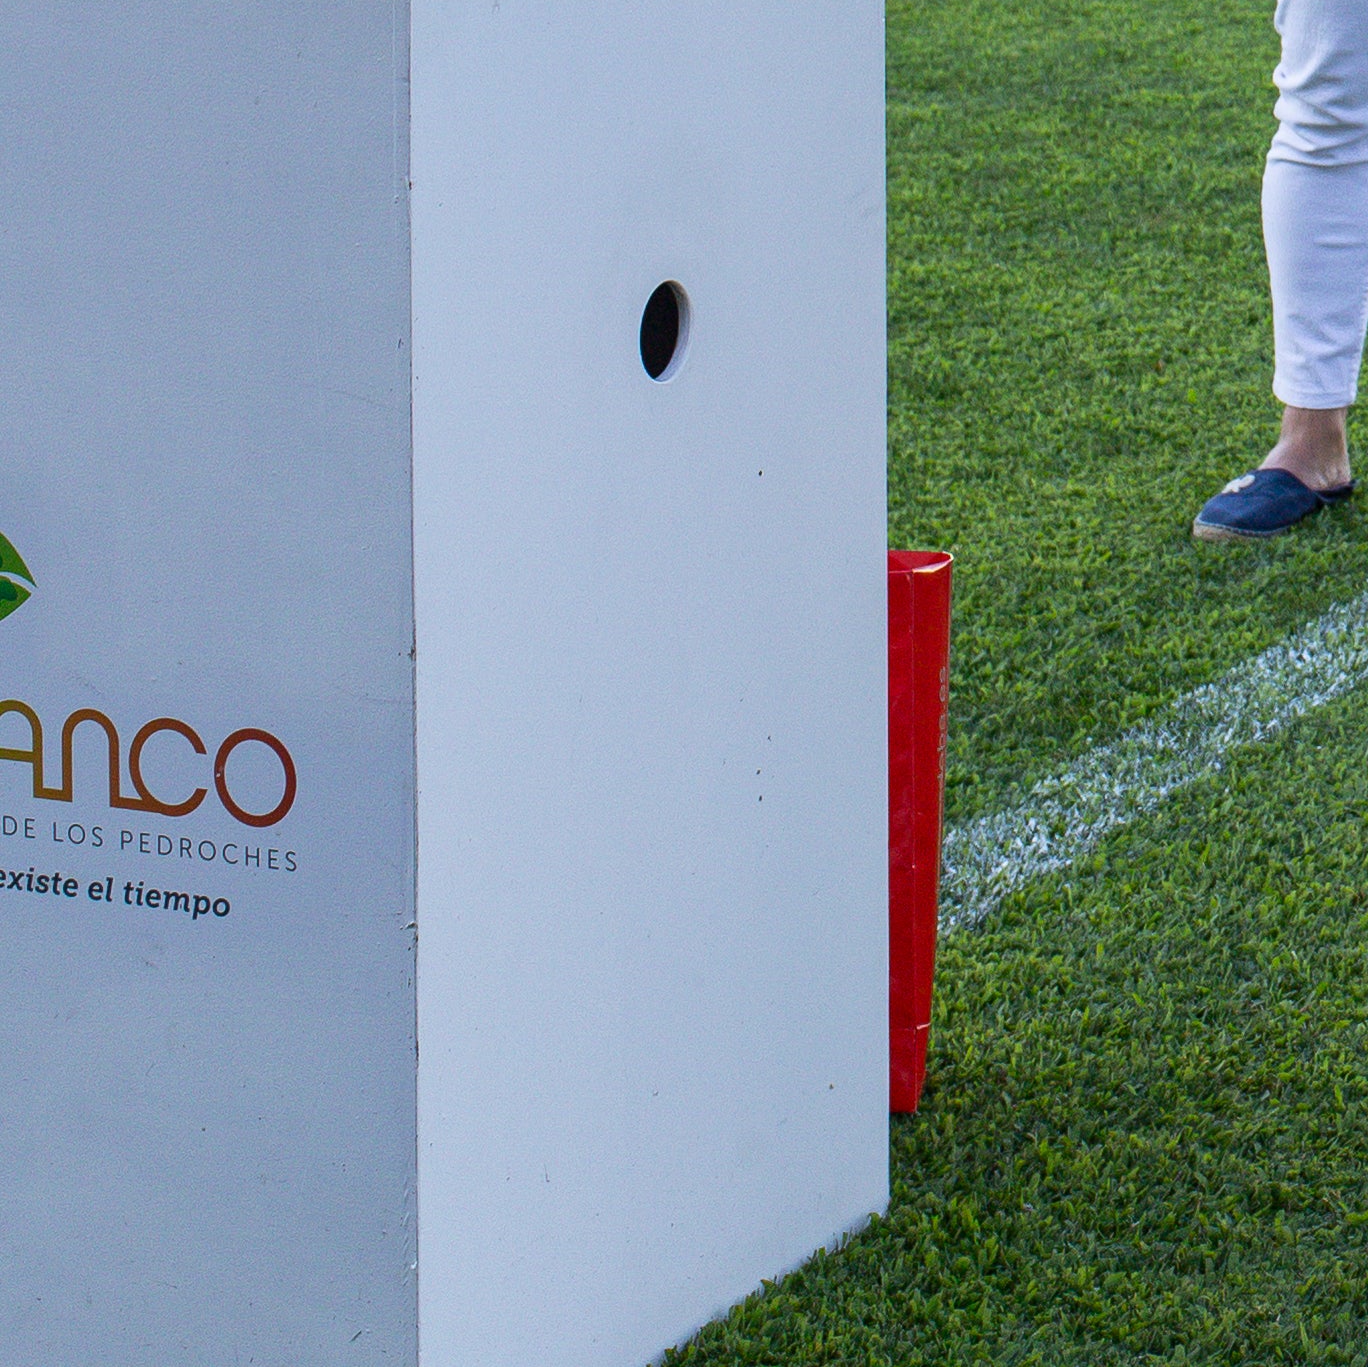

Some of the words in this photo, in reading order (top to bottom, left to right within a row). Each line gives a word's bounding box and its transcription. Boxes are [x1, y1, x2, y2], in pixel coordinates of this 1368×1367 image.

[0, 698, 298, 829] ANCO
[2, 814, 36, 839] DE
[52, 820, 105, 848] LOS
[119, 829, 299, 873] PEDROCHES
[87, 876, 114, 902] el
[122, 879, 232, 920] tiempo
